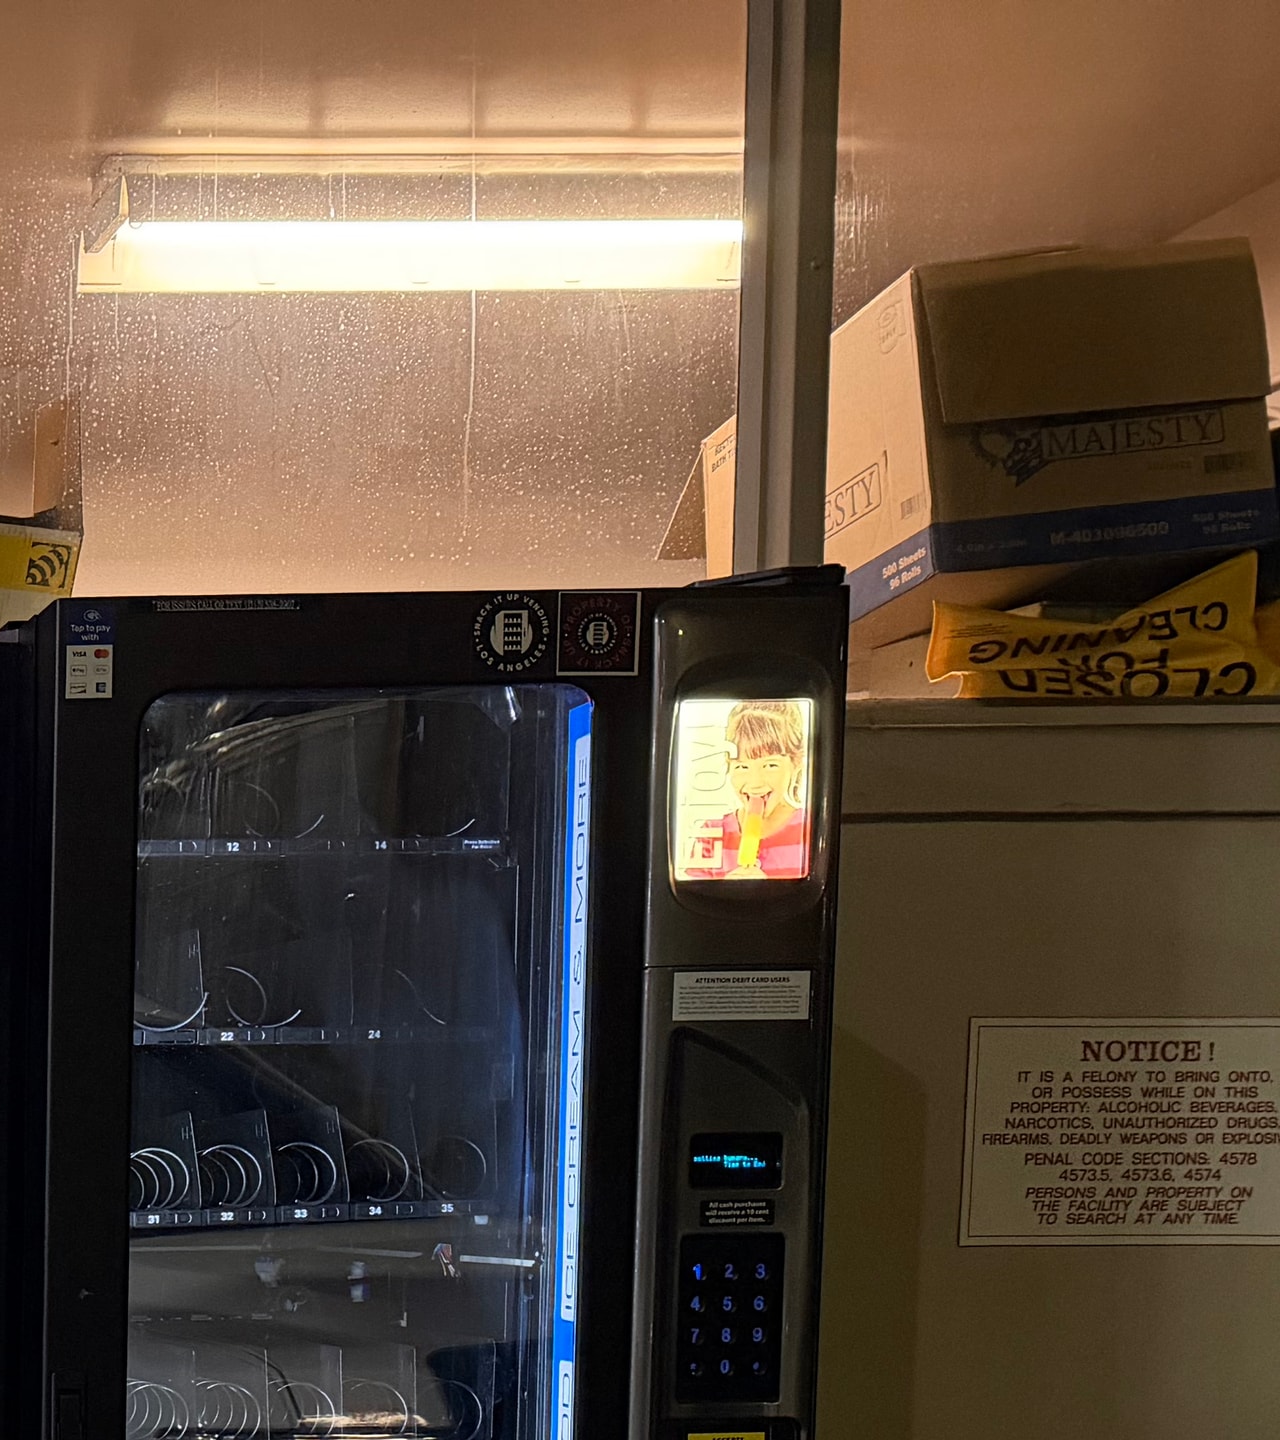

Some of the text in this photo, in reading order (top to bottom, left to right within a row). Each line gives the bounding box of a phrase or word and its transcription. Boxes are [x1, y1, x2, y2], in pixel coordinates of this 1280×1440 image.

[1045, 412, 1217, 459] MAJESTY
[882, 546, 927, 580] 500 Sheets
[889, 564, 922, 591] 96 Rolls
[474, 603, 492, 636] SNACK
[494, 596, 502, 604] IT
[523, 596, 549, 634] VENDING
[476, 643, 545, 671] LOS ANGELES
[227, 842, 239, 851] 12
[562, 755, 589, 1310] ICE CREAM & MORE
[1018, 1071, 1031, 1082] IT
[1040, 1071, 1054, 1082] IS
[1063, 1072, 1073, 1082] A
[1082, 1071, 1137, 1082] FELONY
[1146, 1071, 1166, 1082] TO
[1175, 1071, 1220, 1082] BRING
[1032, 1087, 1258, 1098] OR POSSESS WHILE ON THIS
[1010, 1102, 1090, 1113] PROPERTY:
[1098, 1102, 1181, 1113] ALCOHOLIC
[1103, 1118, 1218, 1129] UNAUTHORIZED
[1060, 1134, 1111, 1145] DEADLY
[1120, 1134, 1187, 1144] WEAPONS
[1195, 1134, 1214, 1144] OR
[1024, 1153, 1072, 1165] PENAL
[1082, 1153, 1123, 1164] CODE
[1219, 1153, 1257, 1164] 4578
[1184, 1169, 1221, 1180] 4574
[1026, 1187, 1253, 1198] PERSONS AND PROPERTY ON
[1032, 1200, 1245, 1211] THE FACILITY ARE SUBJECT
[148, 1206, 382, 1224] 31 32 33 34
[1038, 1213, 1057, 1224] TO
[1066, 1213, 1126, 1224] SEARCH
[1135, 1213, 1155, 1224] AT
[1163, 1213, 1194, 1224] ANY
